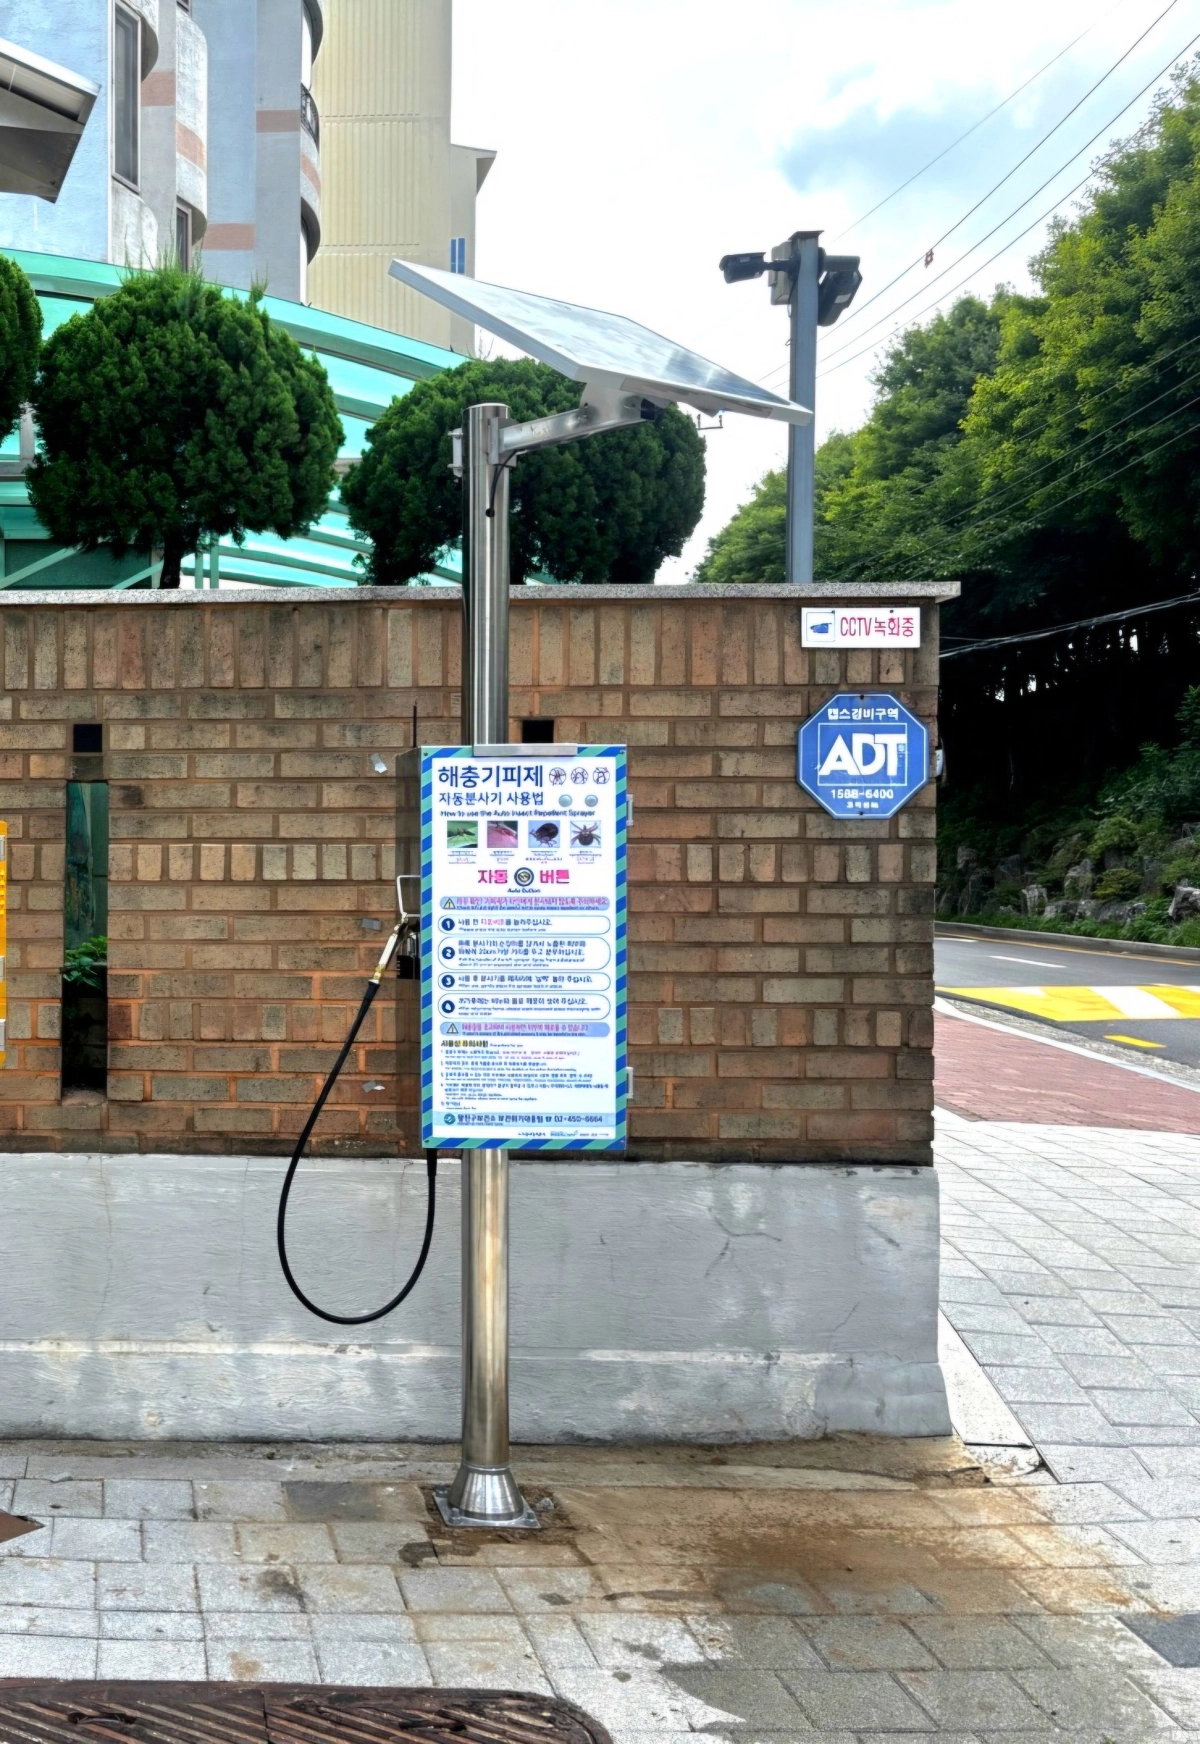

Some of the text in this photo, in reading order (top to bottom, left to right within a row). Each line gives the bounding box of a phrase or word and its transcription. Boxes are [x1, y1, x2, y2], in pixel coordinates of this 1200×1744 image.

[819, 733, 907, 776] ADT
[438, 765, 543, 788] 해충기피제
[439, 791, 544, 806] 자동분사기 사용법
[830, 788, 894, 799] 1588-6400
[477, 869, 570, 884] 자동 버튼
